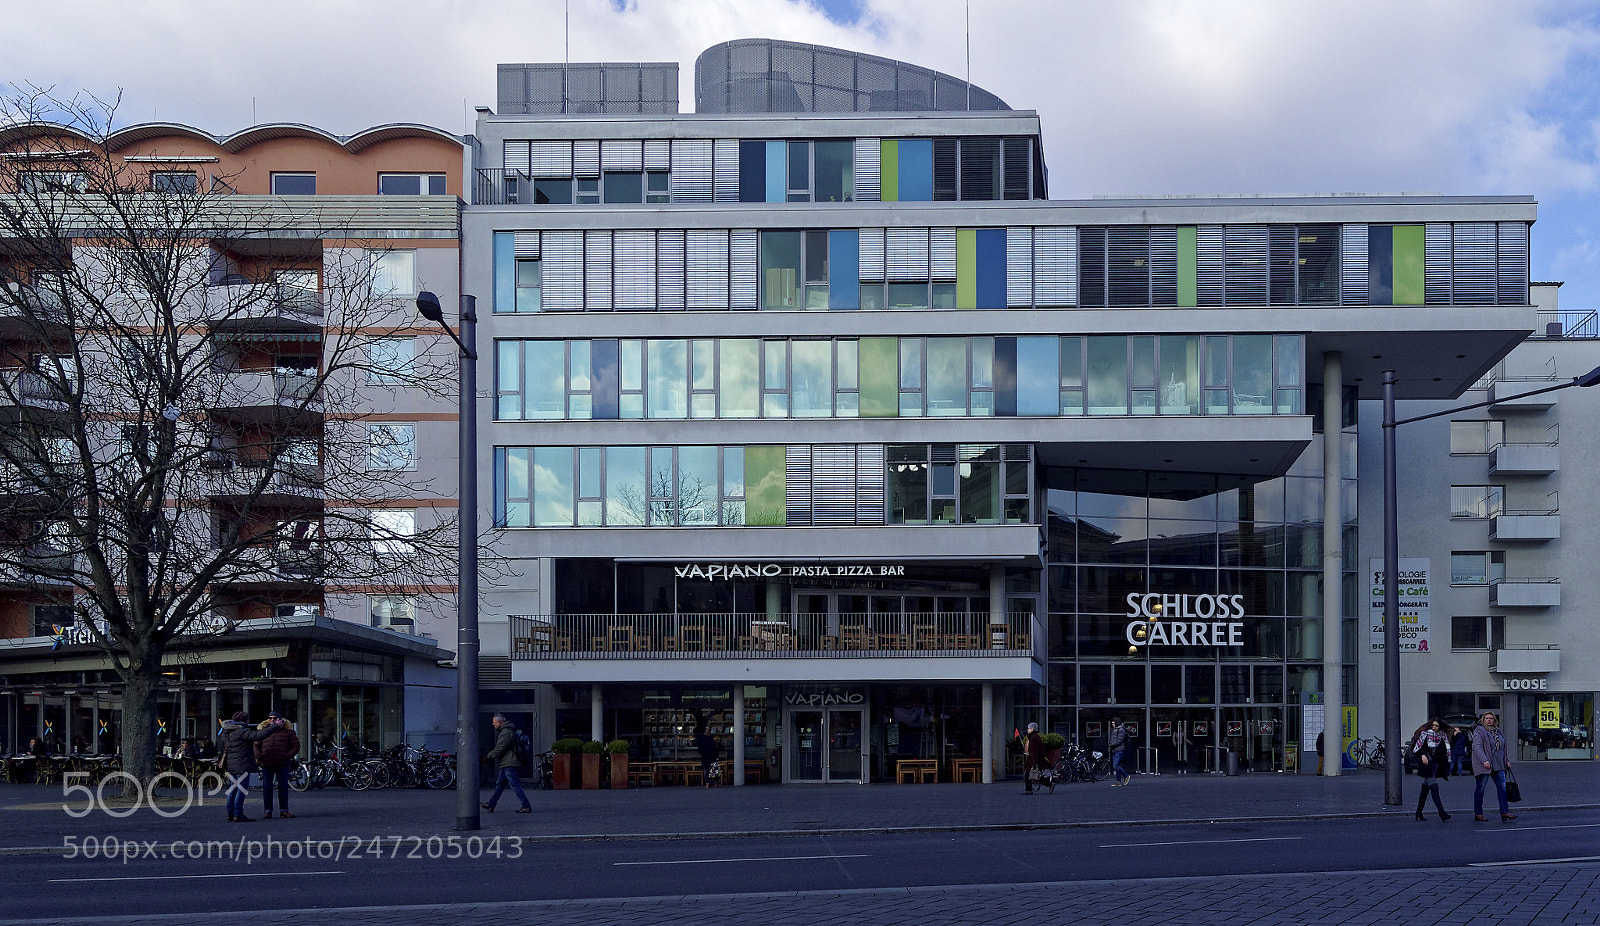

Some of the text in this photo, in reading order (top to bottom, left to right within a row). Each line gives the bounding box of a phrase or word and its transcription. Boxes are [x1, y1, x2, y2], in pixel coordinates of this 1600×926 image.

[674, 563, 904, 581] VAPIANO PASTA PIZZA BAR
[1406, 586, 1428, 596] Café
[1126, 592, 1245, 619] SCHLOSS
[1126, 620, 1244, 646] CARREE
[1503, 679, 1547, 690] LOOSE
[785, 690, 864, 706] VAPIANO
